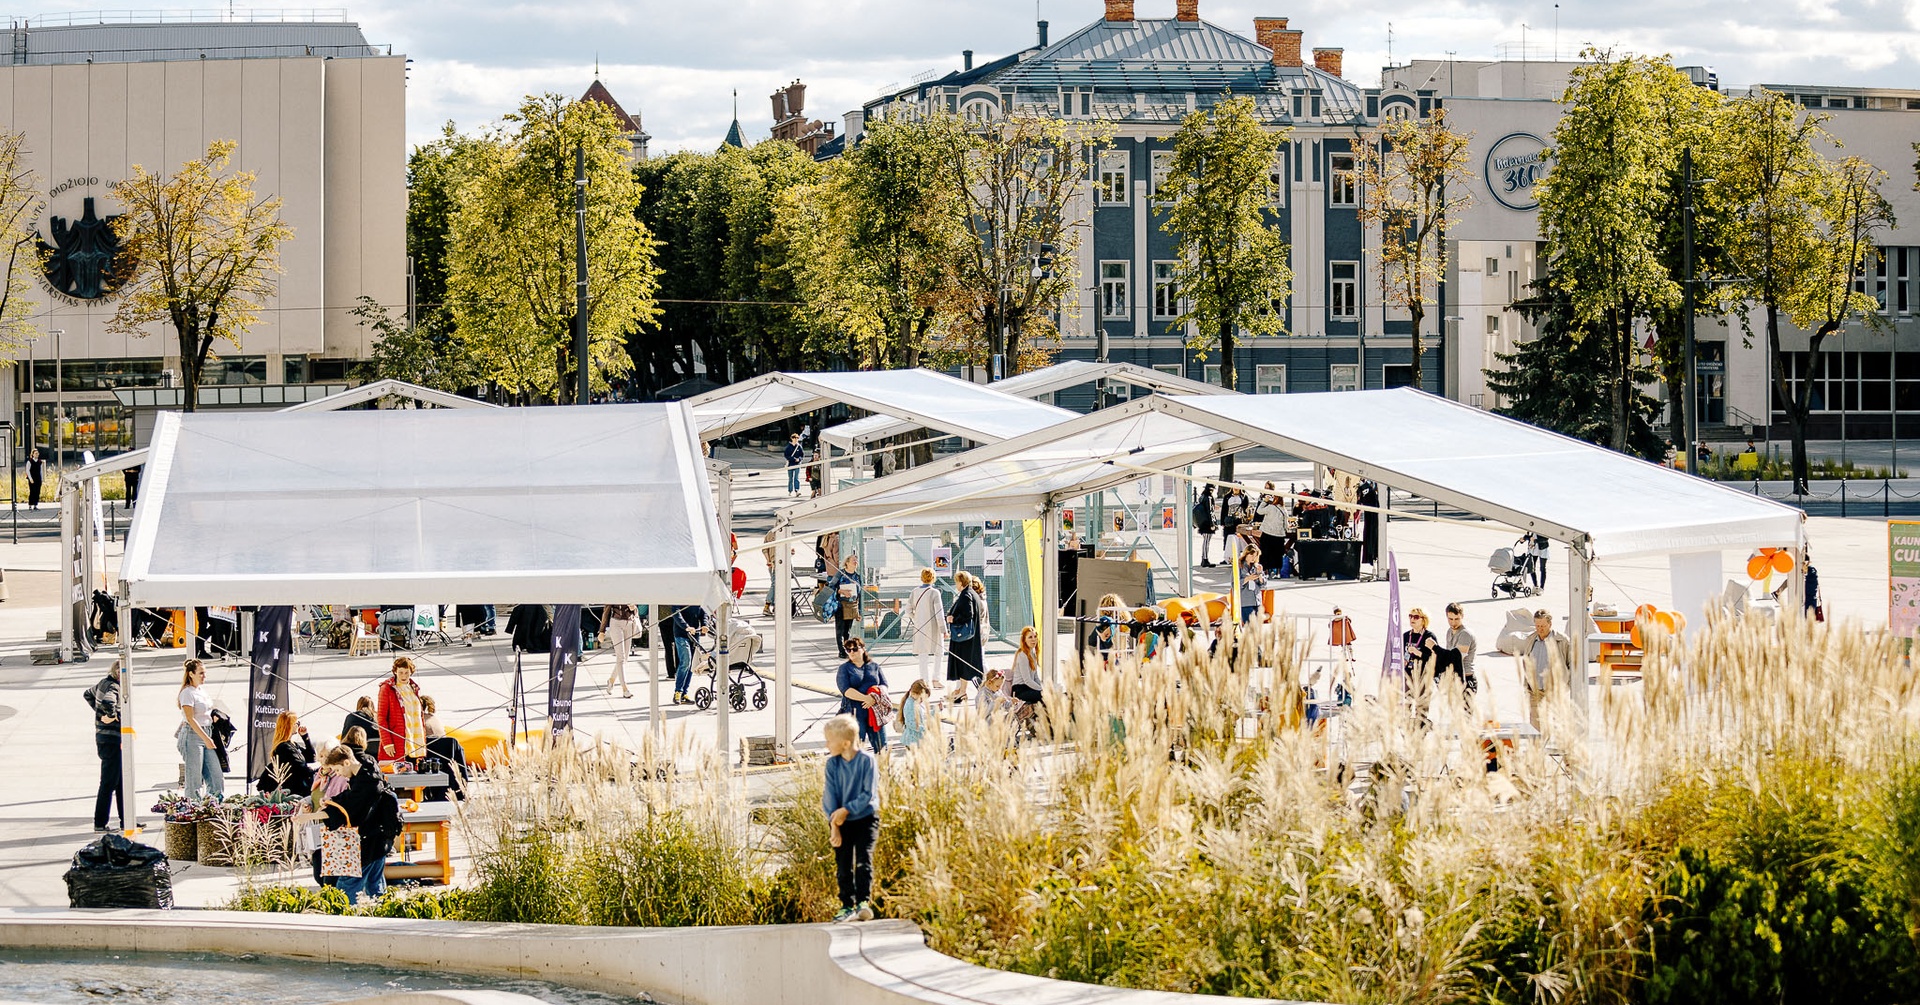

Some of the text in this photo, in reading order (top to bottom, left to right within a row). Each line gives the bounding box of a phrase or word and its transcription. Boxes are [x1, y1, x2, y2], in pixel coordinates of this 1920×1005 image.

[49, 176, 99, 198] DIDŽIOJO
[1893, 536, 1920, 546] KAUN
[1894, 548, 1920, 562] CUL
[259, 631, 269, 643] K
[555, 636, 562, 649] K
[564, 653, 573, 665] K
[262, 664, 271, 675] C
[557, 670, 564, 682] C
[255, 691, 276, 700] Kauno
[553, 699, 571, 707] Kauno
[553, 712, 569, 722] Kultūr
[254, 719, 277, 729] Centra
